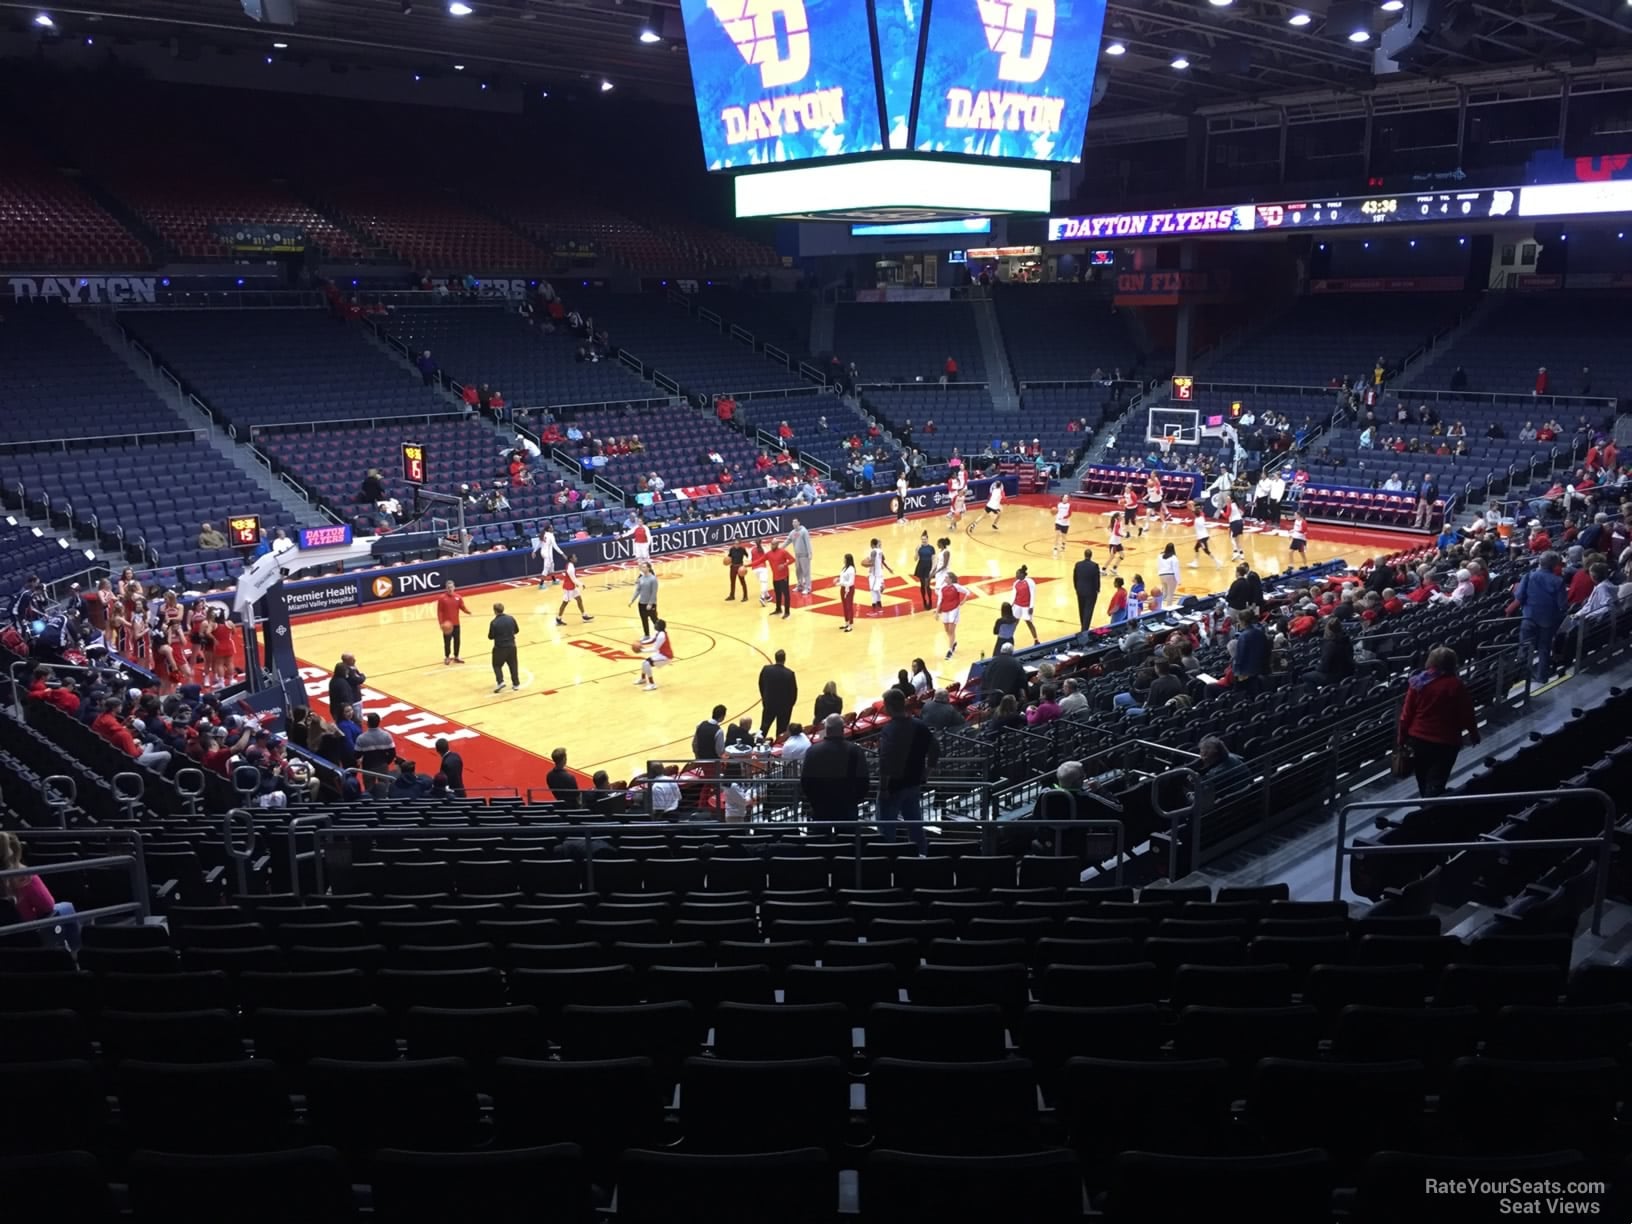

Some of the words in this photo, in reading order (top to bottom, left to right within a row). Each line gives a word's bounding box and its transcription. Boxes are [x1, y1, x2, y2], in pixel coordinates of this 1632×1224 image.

[722, 87, 845, 144] DAYTON
[946, 88, 1065, 132] DAYTON
[1361, 199, 1397, 214] 43:36
[1064, 214, 1147, 238] DAYTON
[1148, 209, 1233, 233] FLYERS
[903, 494, 927, 511] PNC
[241, 528, 253, 541] 15
[306, 526, 345, 539] DAYTON
[307, 535, 345, 546] FLYERS
[602, 526, 709, 561] UNIERSITY
[711, 528, 720, 541] of
[723, 515, 780, 542] DAYTON
[399, 571, 441, 593] PNC
[287, 588, 330, 604] Premier
[330, 584, 358, 599] Health
[288, 601, 309, 612] Miami
[310, 598, 328, 610] Valley
[328, 595, 355, 607] Hospital
